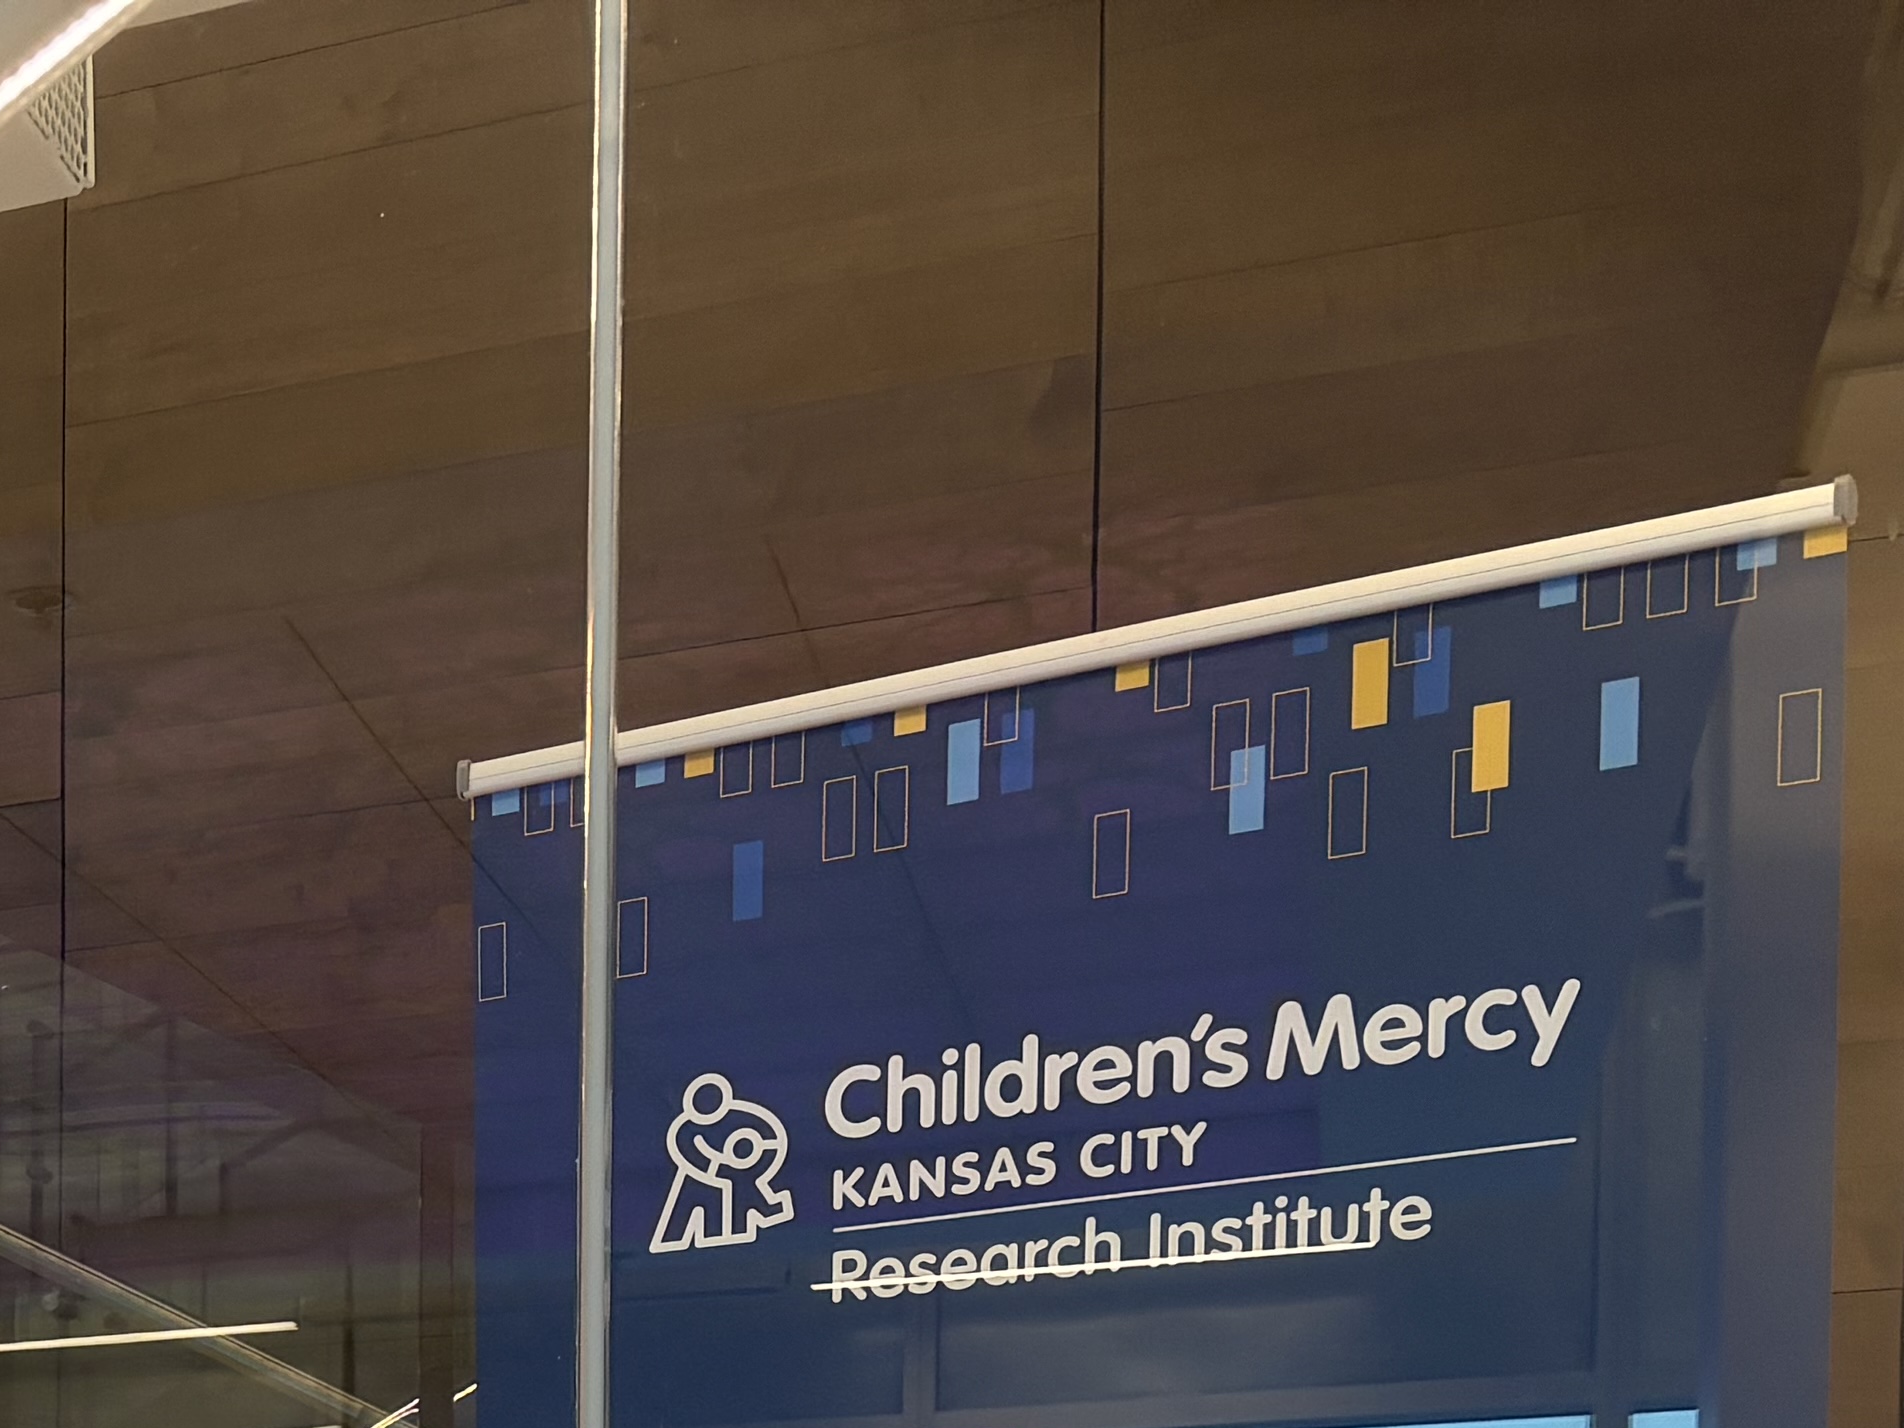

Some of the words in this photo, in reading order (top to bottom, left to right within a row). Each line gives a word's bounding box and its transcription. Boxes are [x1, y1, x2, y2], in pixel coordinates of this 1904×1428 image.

[825, 1013, 1248, 1138] Children's
[1266, 977, 1580, 1081] Mercy
[832, 1141, 1056, 1210] KANSAS
[1081, 1121, 1207, 1178] CITY
[832, 1216, 1121, 1302] Research
[1149, 1189, 1433, 1266] Institute
